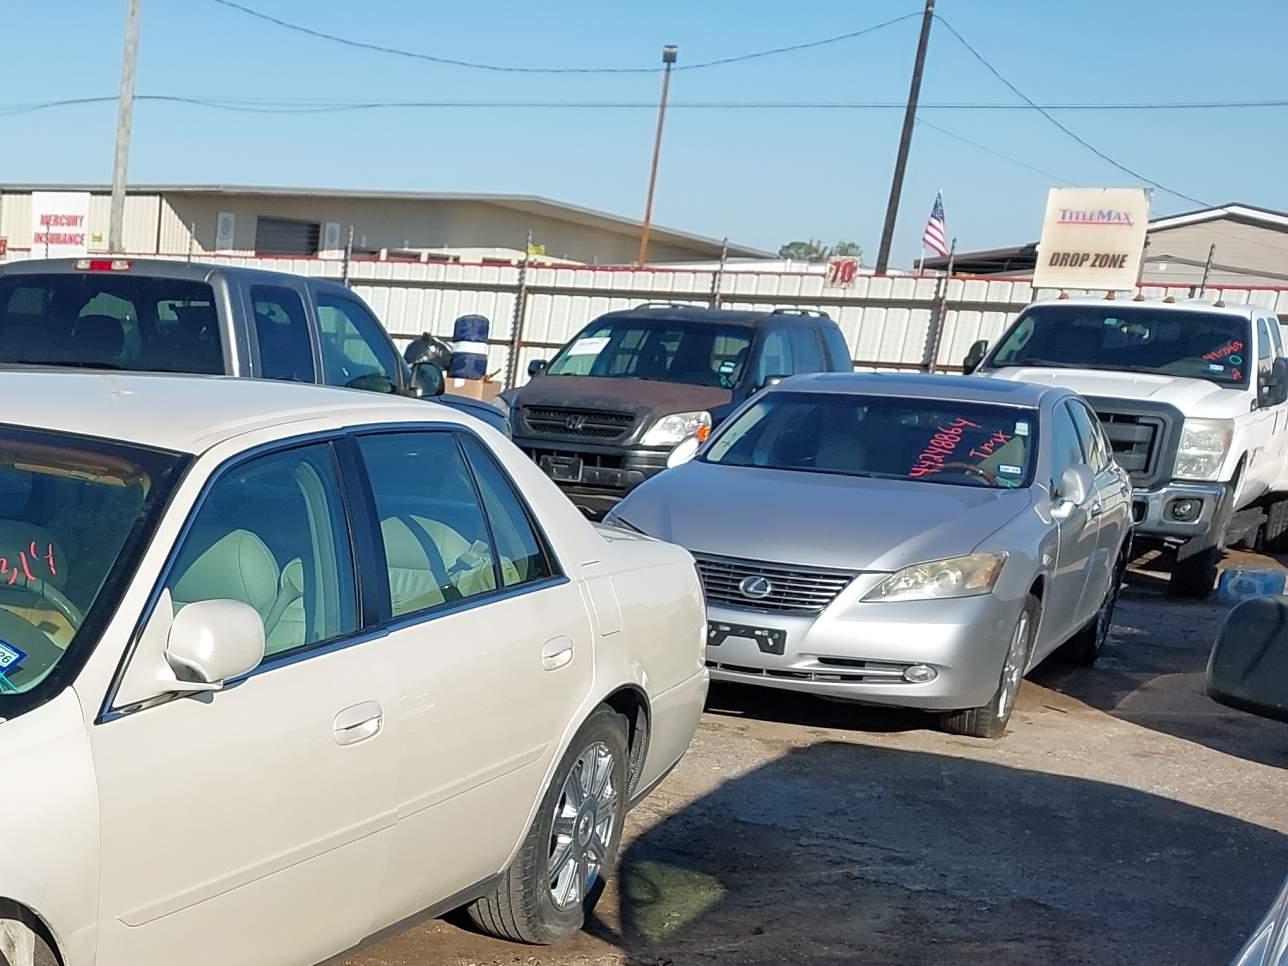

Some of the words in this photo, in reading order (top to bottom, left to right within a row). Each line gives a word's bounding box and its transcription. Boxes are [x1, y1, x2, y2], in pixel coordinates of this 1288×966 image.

[33, 232, 85, 246] INSURANCE
[1048, 252, 1090, 267] DROP
[1090, 253, 1129, 268] ZONE
[829, 261, 857, 283] 70
[909, 417, 982, 478] 44248864
